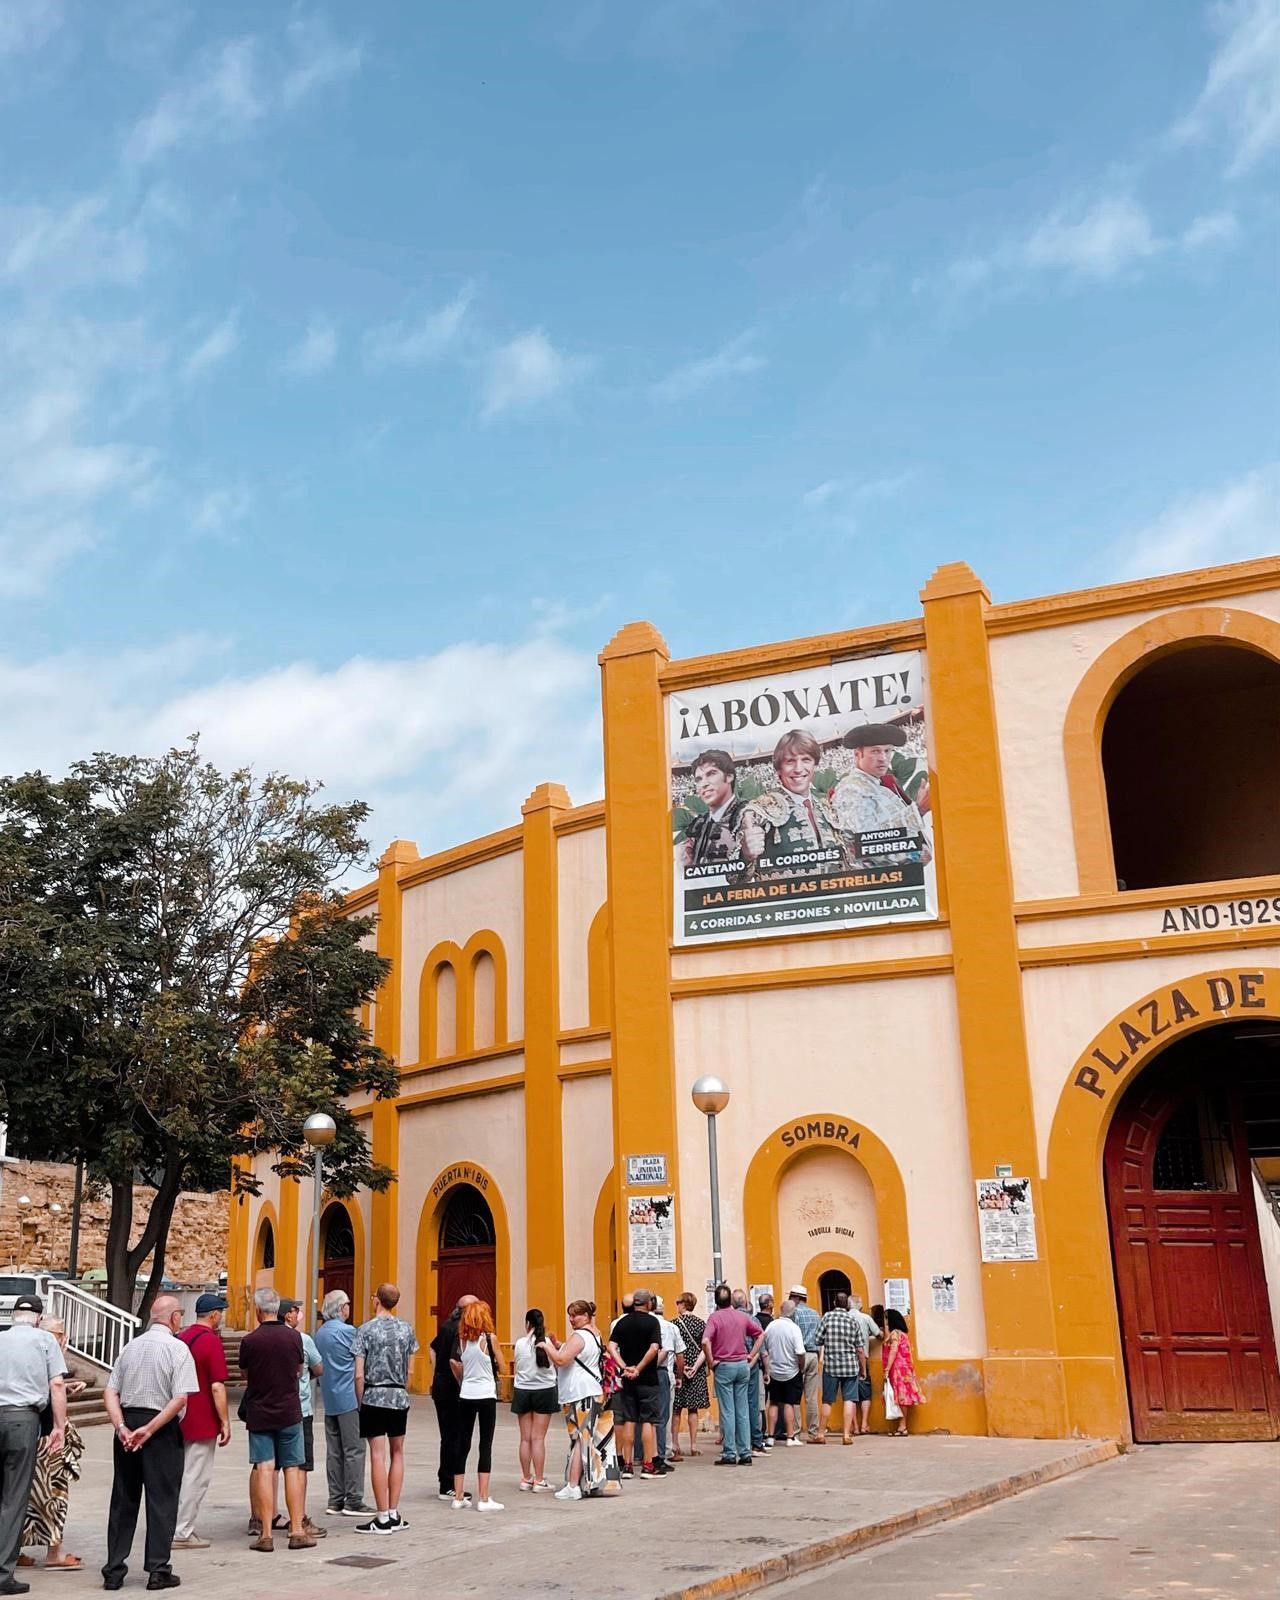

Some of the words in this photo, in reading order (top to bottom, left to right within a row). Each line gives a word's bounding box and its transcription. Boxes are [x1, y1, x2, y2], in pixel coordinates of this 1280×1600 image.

[679, 670, 912, 740] ¡ABÓNATE!
[860, 829, 901, 841] ANTONIO
[861, 840, 917, 855] FERRERA
[685, 861, 745, 877] CAYETANO
[760, 858, 773, 868] EL
[776, 849, 840, 866] CORDOBÉS
[702, 892, 724, 906] ¡LA
[727, 886, 766, 901] FERIA
[769, 884, 787, 897] DE
[790, 880, 817, 894] LAS
[820, 871, 903, 890] ESTRELLAS!
[689, 921, 698, 931] 4
[700, 914, 762, 929] CORRIDAS
[775, 906, 831, 921] REJONES
[843, 897, 919, 914] NOVILLADA
[1074, 988, 1200, 1099] PLAZA
[1207, 974, 1266, 1012] DE
[781, 1121, 860, 1149] SOMBRA
[642, 1158, 660, 1166] PLAZA
[433, 1168, 462, 1197] PUERTA
[475, 1172, 489, 1190] BIS
